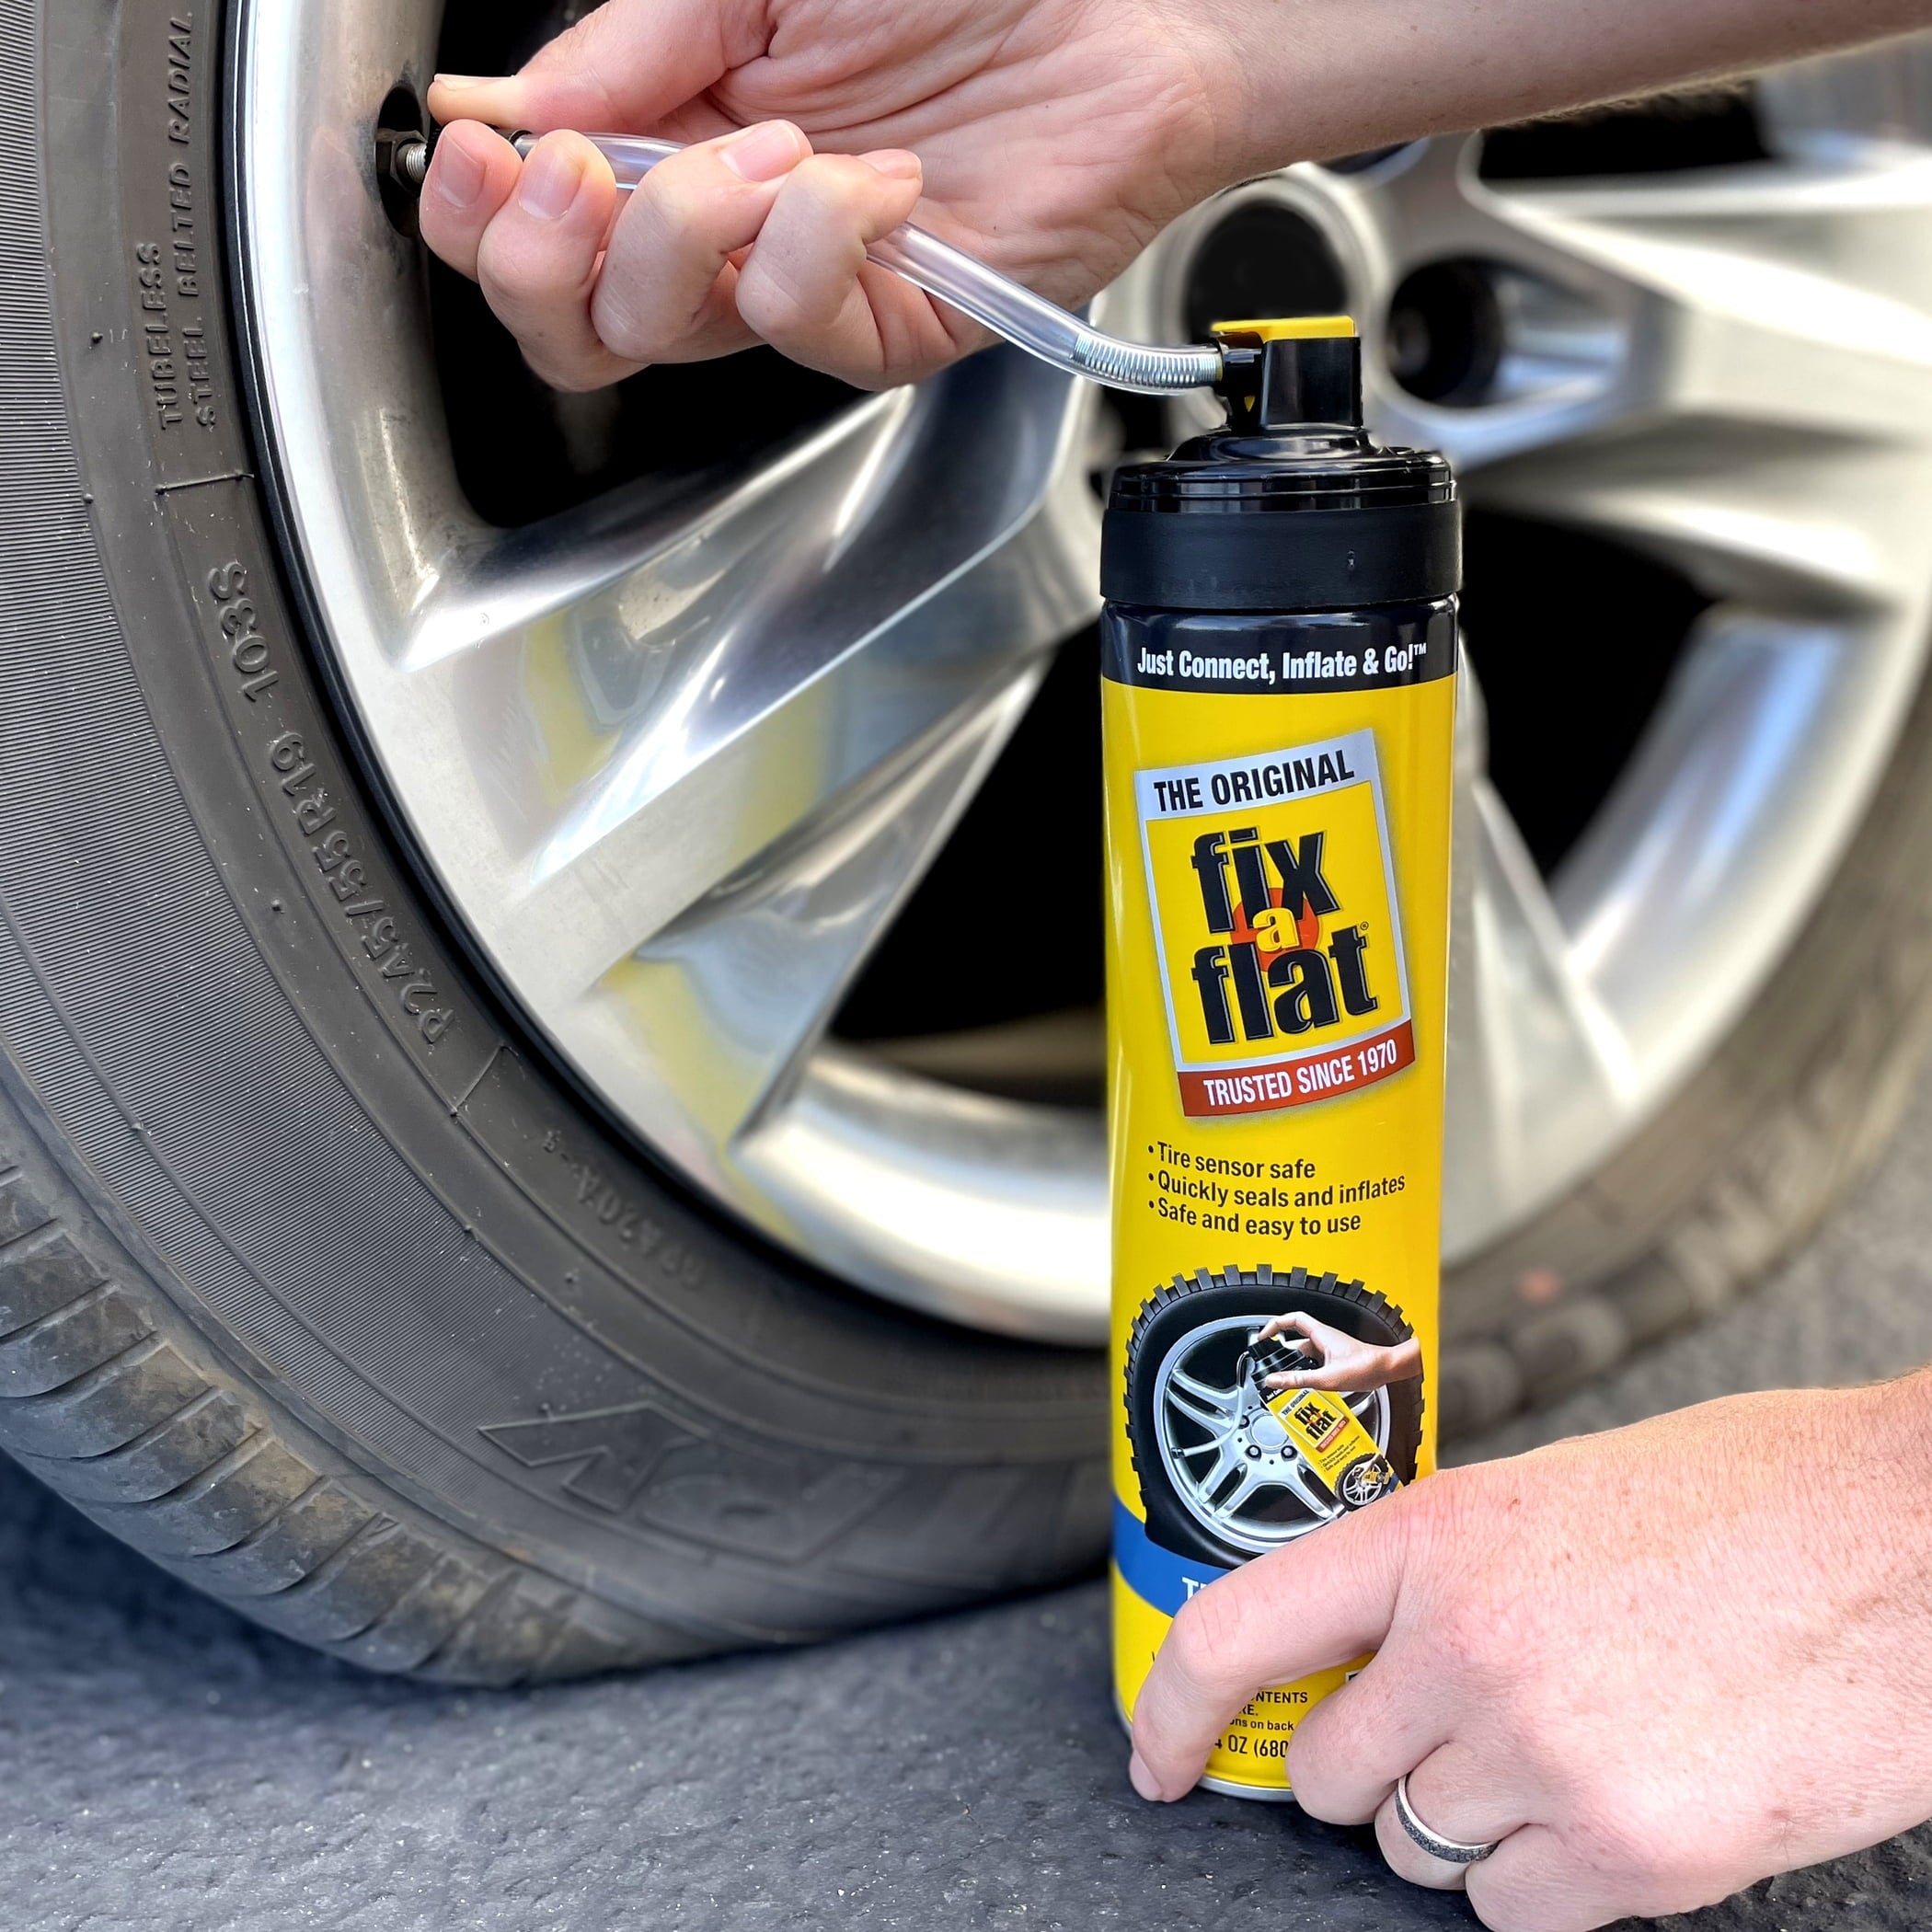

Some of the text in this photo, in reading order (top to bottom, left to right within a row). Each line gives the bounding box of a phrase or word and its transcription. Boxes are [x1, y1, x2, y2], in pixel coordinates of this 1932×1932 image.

[168, 11, 218, 431] STEEL BELTED RADIAL
[136, 241, 184, 431] TUBELESS
[208, 561, 279, 702] 103S
[1137, 647, 1174, 676] Just
[1179, 650, 1275, 685] Connect,
[1282, 650, 1357, 680] Inflate
[1363, 648, 1378, 675] &
[1154, 750, 1354, 812] THE ORIGINAL
[1190, 825, 1341, 934] fix
[1252, 906, 1300, 953] a
[1203, 1039, 1397, 1106] TRUSTED SINCE 1970
[1157, 1141, 1316, 1179] Tire sensor safe
[1157, 1169, 1406, 1208] Quickly seals and inflates
[1158, 1197, 1362, 1241] Safe and easy to use
[1251, 1691, 1308, 1703] NTENTS
[1228, 1734, 1248, 1754] OZ
[1250, 1720, 1264, 1730] on
[1267, 1719, 1294, 1731] back
